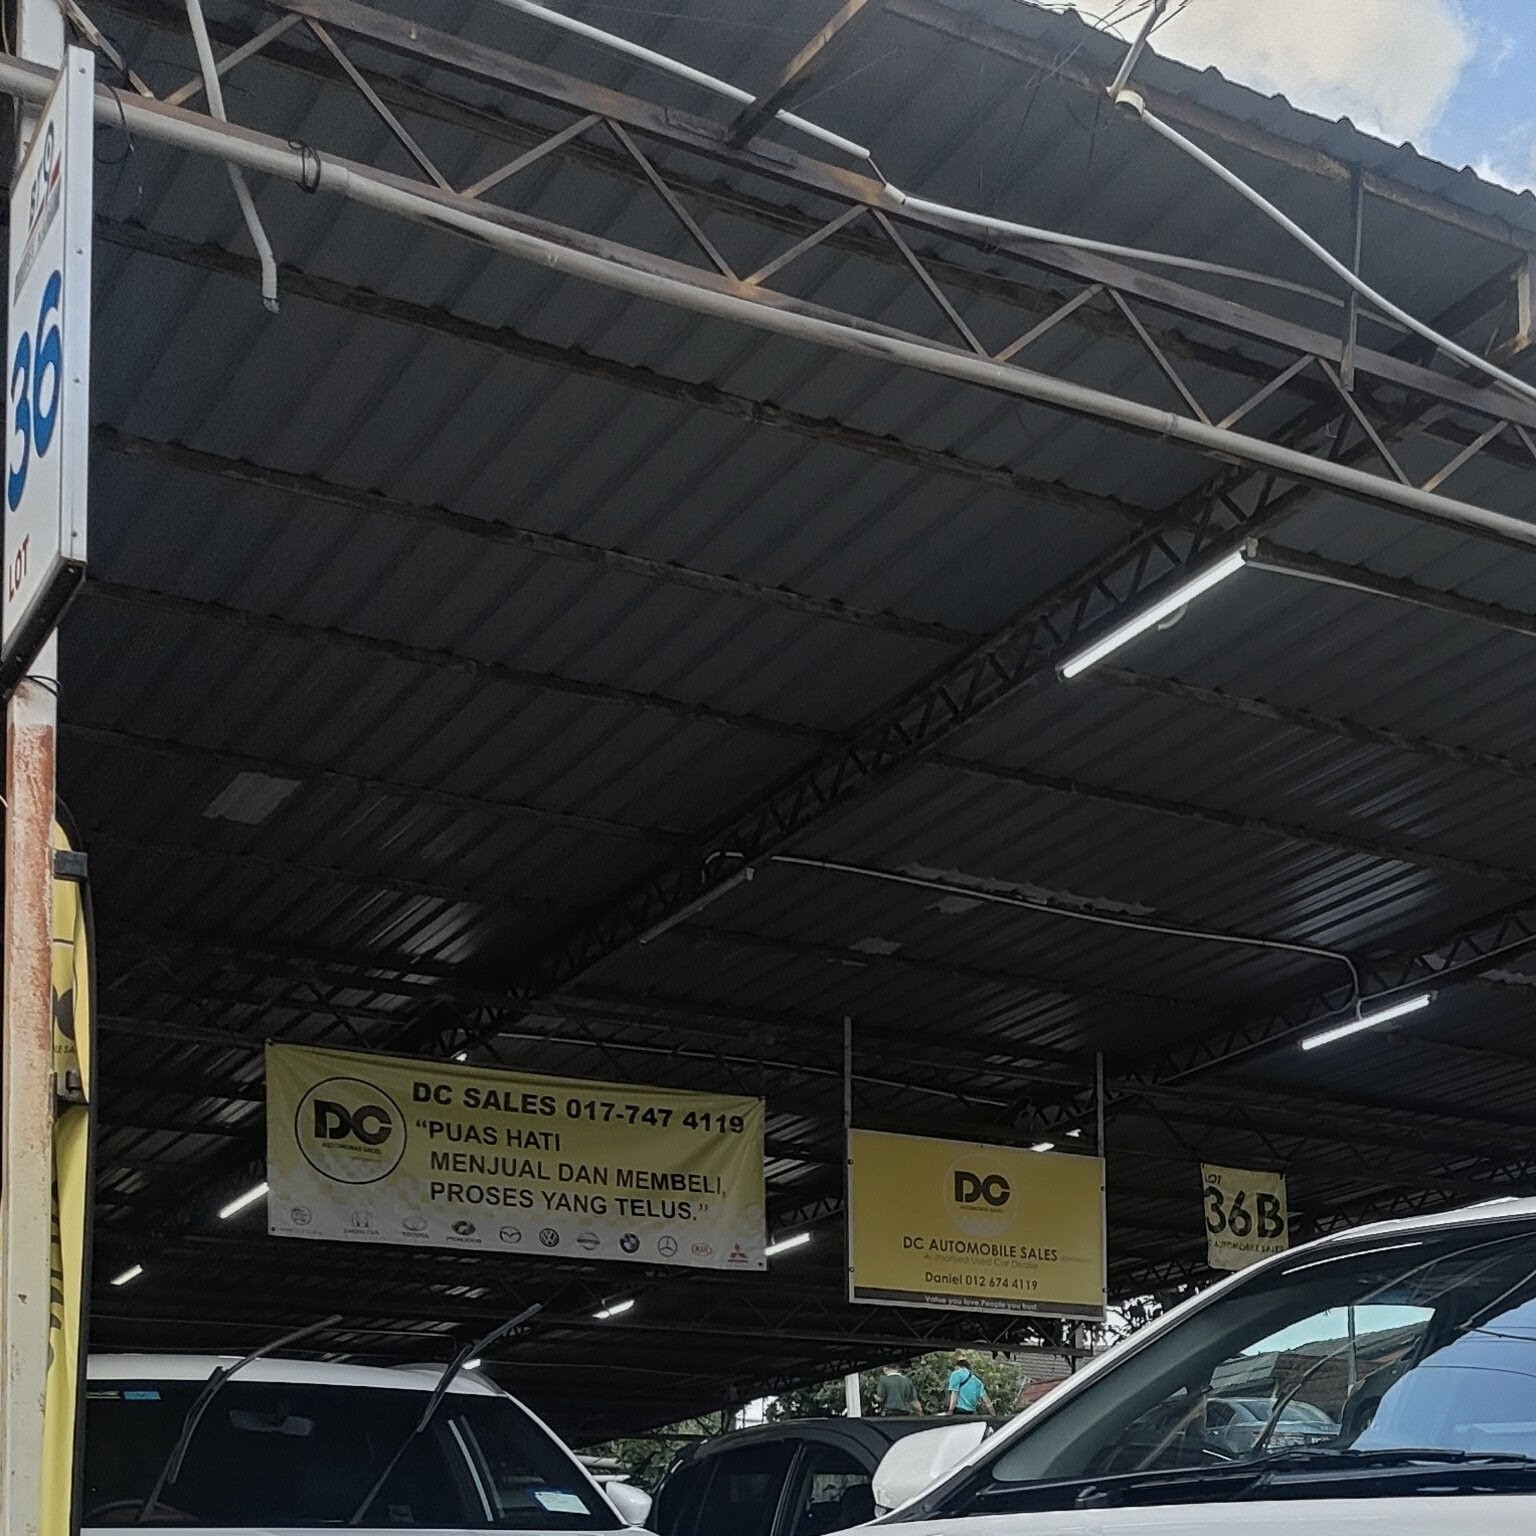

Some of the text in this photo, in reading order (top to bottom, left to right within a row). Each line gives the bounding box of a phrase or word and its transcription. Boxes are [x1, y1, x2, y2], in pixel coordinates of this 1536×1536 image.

[8, 268, 61, 512] 36
[8, 534, 30, 602] LOT
[314, 1100, 392, 1145] DC
[413, 1081, 744, 1134] DC SALES 017-747 4119
[506, 1129, 560, 1151] HATI
[431, 1151, 726, 1198] MENJUAL DAN MEMBELI,
[954, 1171, 1010, 1206] DC
[431, 1181, 533, 1208] PROSES
[541, 1190, 607, 1215] YANG
[1203, 1186, 1284, 1238] 36B
[903, 1236, 924, 1250] DC
[929, 1238, 1017, 1258] AUTOMOBILE
[1020, 1246, 1058, 1262] SALES
[993, 1259, 1009, 1267] Car
[925, 1271, 1038, 1291] Daniel 012 674 4119
